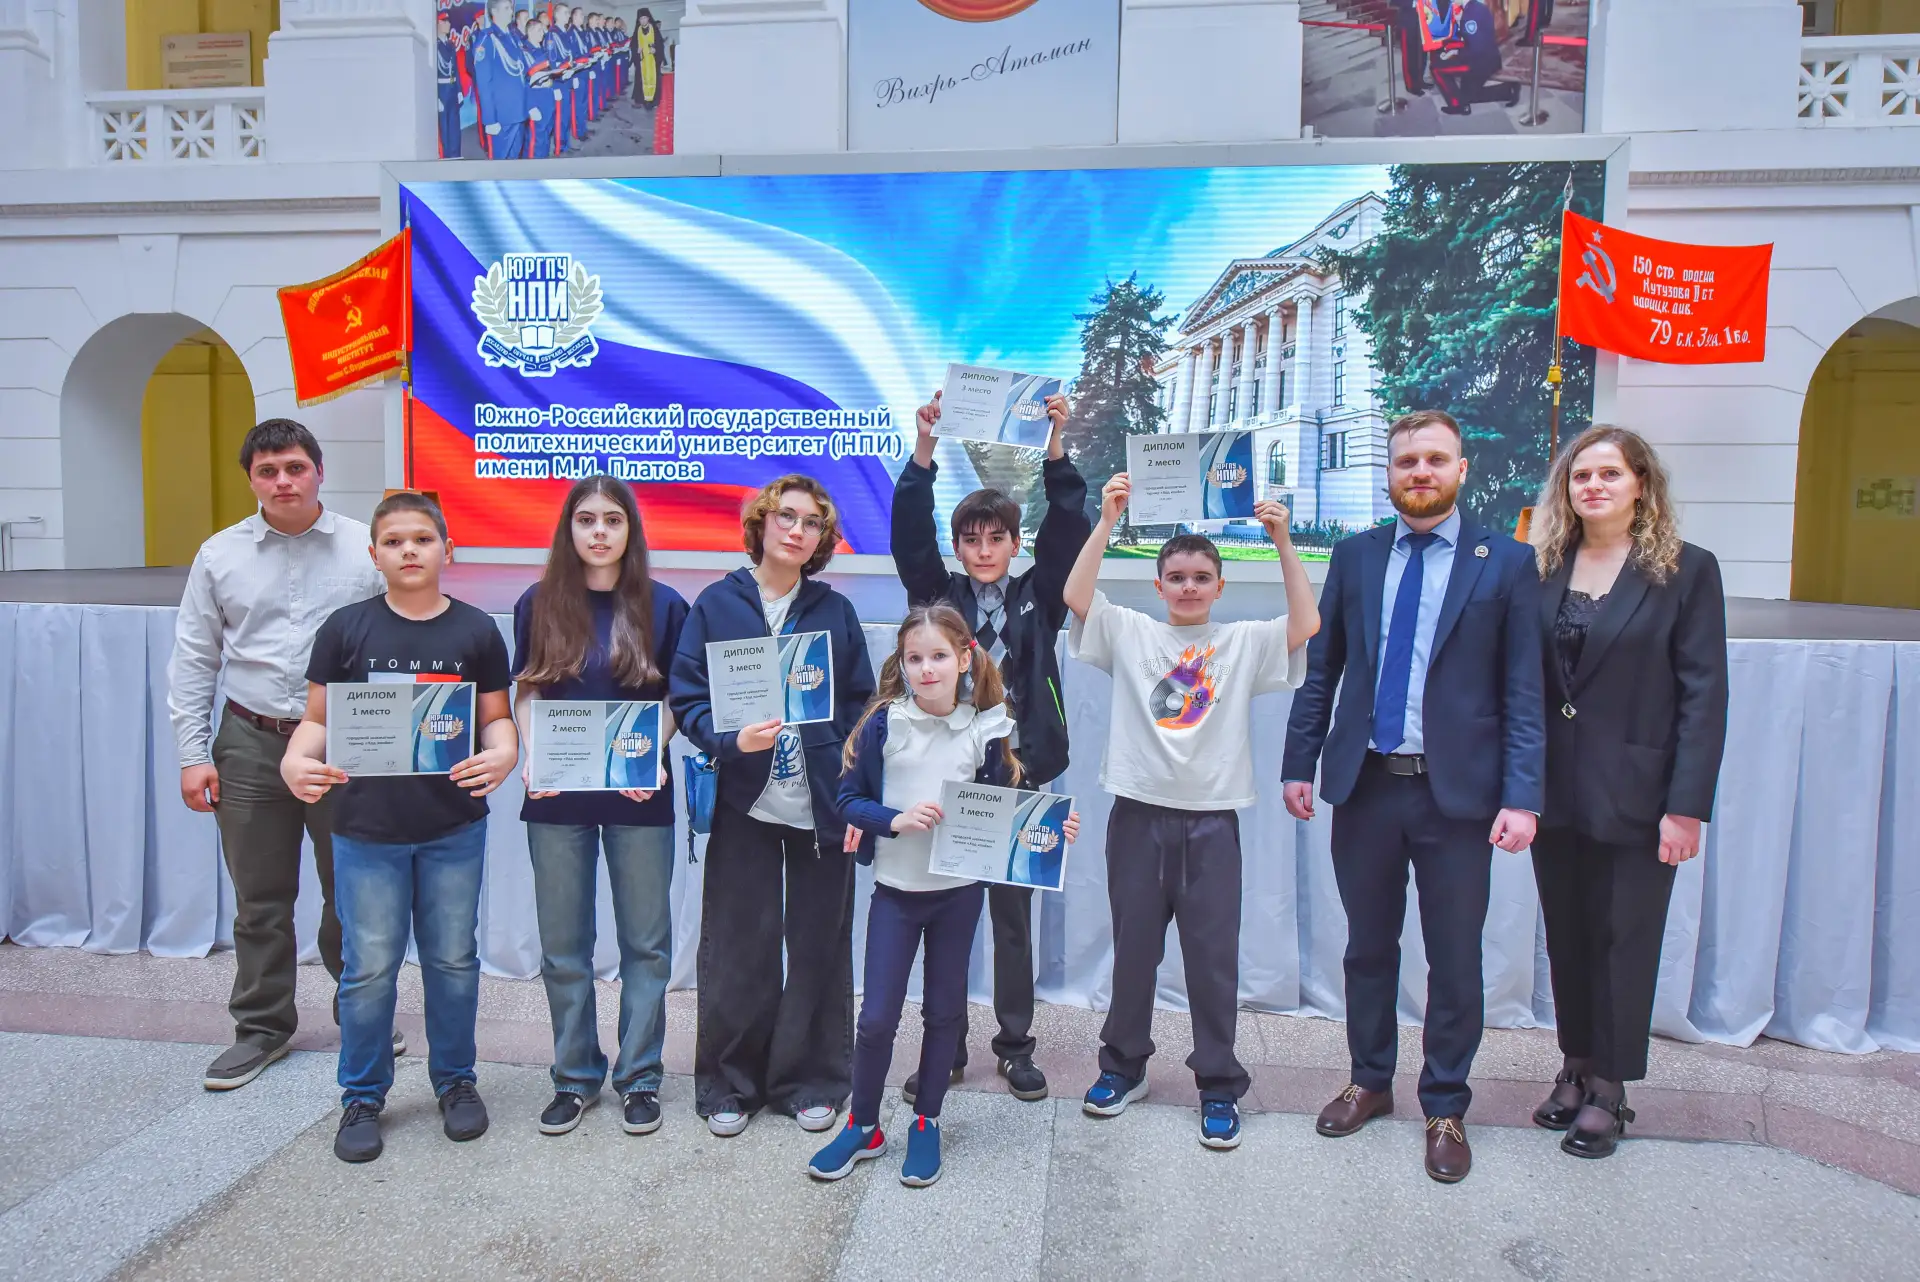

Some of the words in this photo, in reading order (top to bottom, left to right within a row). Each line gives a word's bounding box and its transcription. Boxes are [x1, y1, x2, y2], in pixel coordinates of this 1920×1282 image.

[873, 37, 1092, 109] Вихрь-Атаман
[507, 256, 568, 280] ЮРГПУ
[1633, 255, 1653, 276] 150
[507, 280, 569, 321] НПИ
[1649, 318, 1672, 345] 79
[961, 372, 999, 383] ДИПЛОМ
[1019, 405, 1039, 415] НПИ
[476, 404, 683, 426] Южно-Российский
[689, 406, 891, 431] государственный
[476, 432, 673, 452] политехнический
[680, 436, 825, 457] университет
[831, 433, 903, 459] (НПИ)
[1143, 443, 1185, 452] ДИПЛОМ
[476, 460, 548, 476] имени
[610, 459, 702, 477] Платова
[1148, 459, 1153, 467] 2
[1216, 469, 1237, 481] НПИ
[723, 646, 765, 658] ДИПЛОМ
[369, 658, 462, 671] TOMMY
[736, 664, 761, 672] место
[796, 671, 815, 683] НПИ
[347, 691, 396, 701] ДИПЛОМ
[352, 707, 357, 716] 1
[548, 709, 592, 718] ДИПЛОМ
[430, 721, 453, 733] НПИ
[621, 739, 642, 750] НПИ
[957, 790, 1002, 804] ДИПЛОМ
[960, 807, 965, 815] 1
[967, 810, 995, 818] место
[1027, 831, 1049, 845] НПИ
